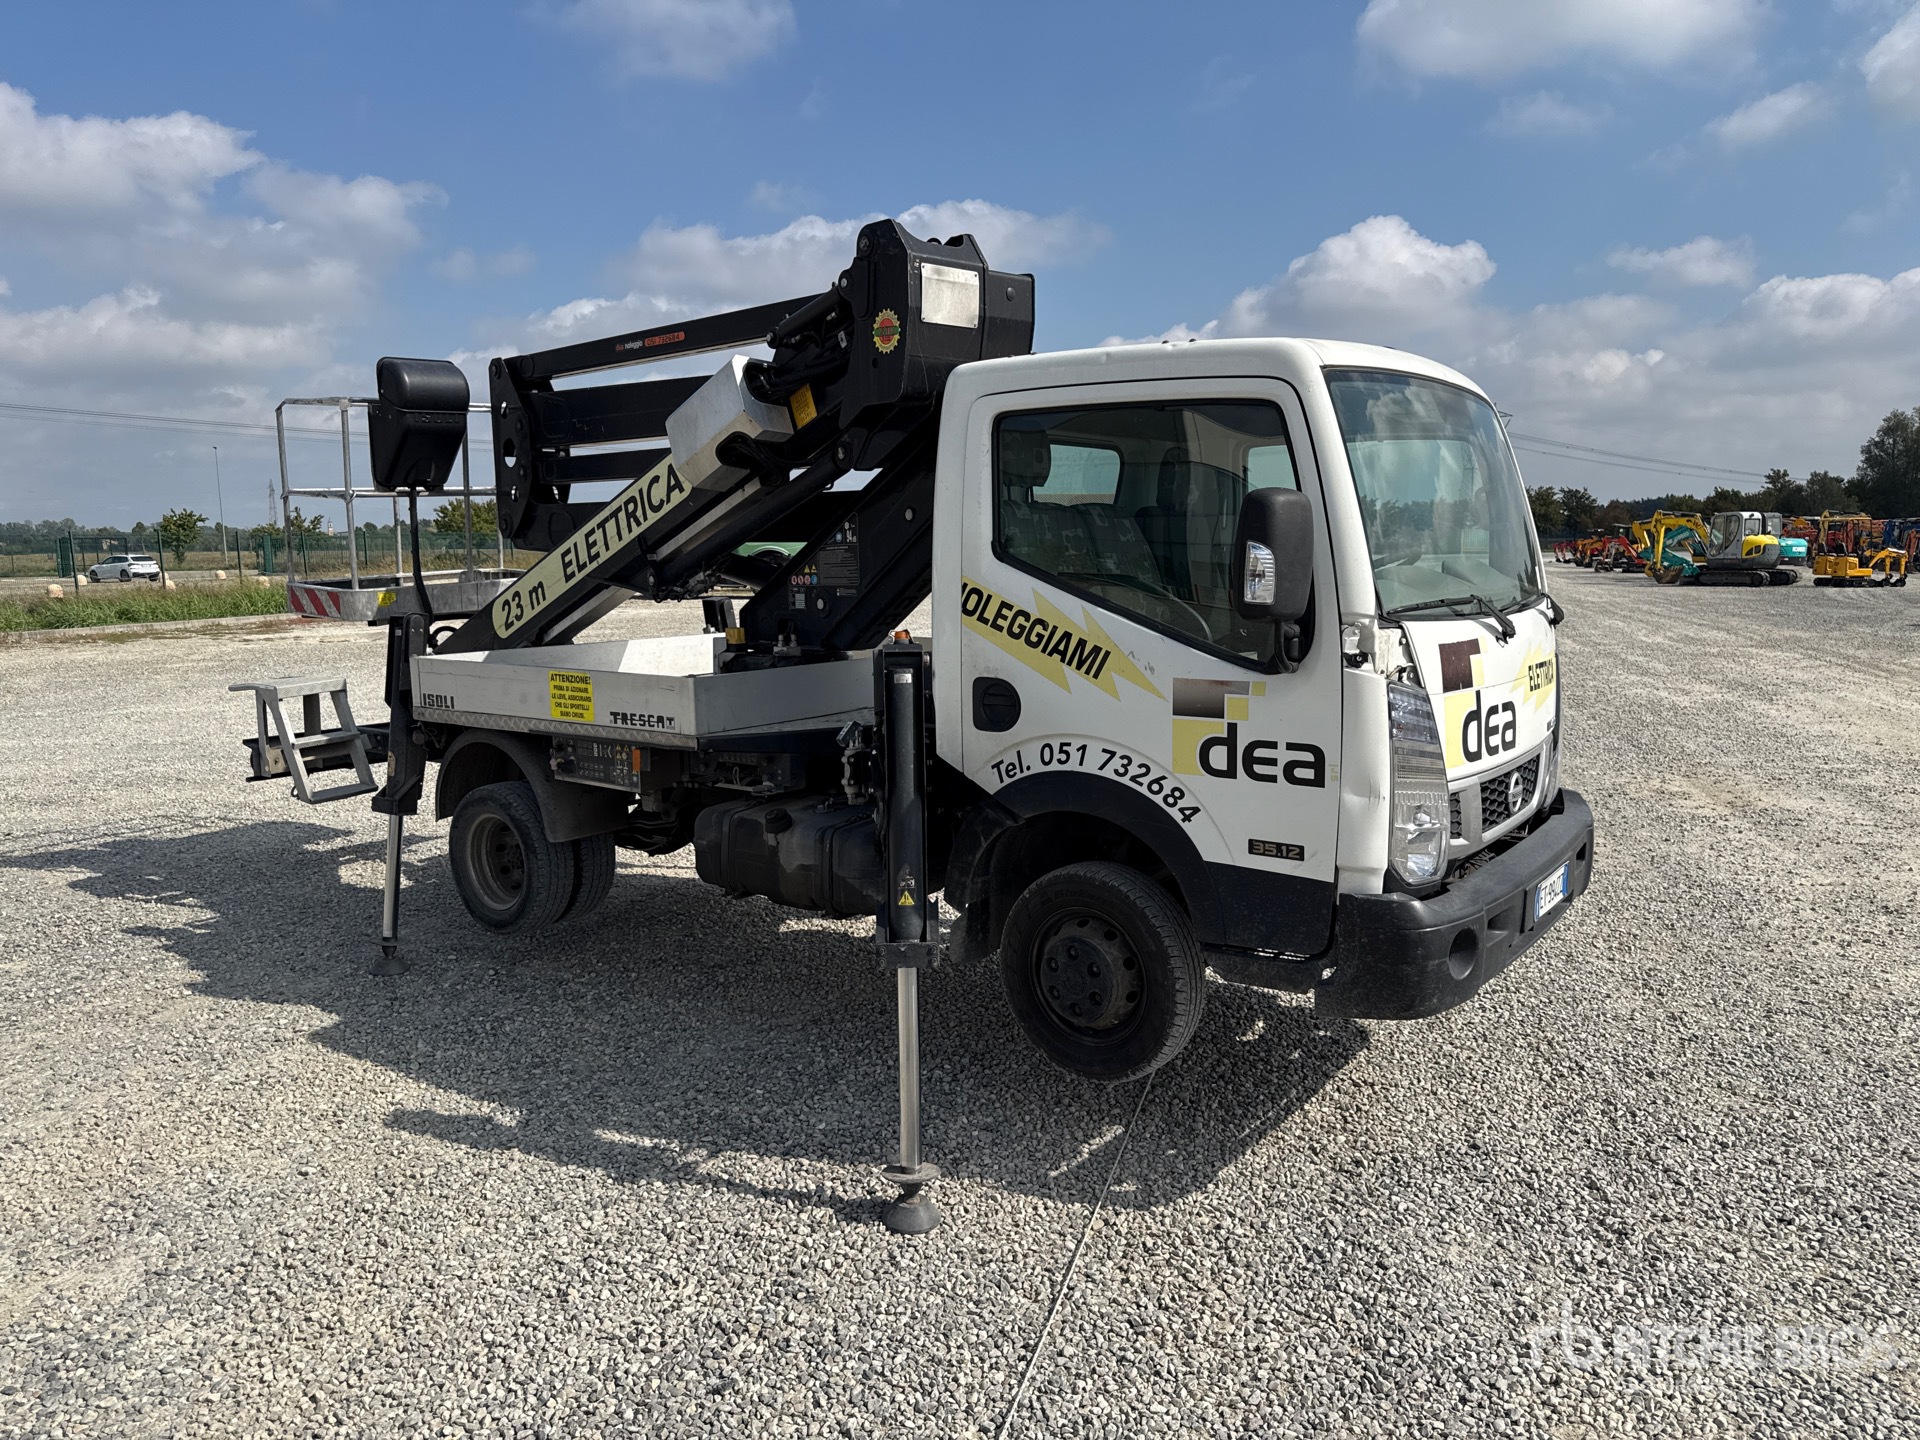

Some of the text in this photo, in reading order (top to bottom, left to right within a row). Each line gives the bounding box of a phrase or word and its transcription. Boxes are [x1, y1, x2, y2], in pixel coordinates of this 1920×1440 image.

[658, 333, 680, 345] 732684
[502, 463, 686, 632] 23 m ELETTRICA
[961, 582, 1112, 680] OLEGGIAMI
[550, 673, 591, 685] ATTENZIONE!
[423, 693, 455, 710] ISOLI
[557, 693, 568, 701] LEVE,
[570, 703, 590, 711] SPORTELLI
[1462, 689, 1517, 763] dea
[1199, 722, 1326, 789] dea
[991, 742, 1202, 824] Tel. 051 732684
[1252, 840, 1300, 859] 35.12
